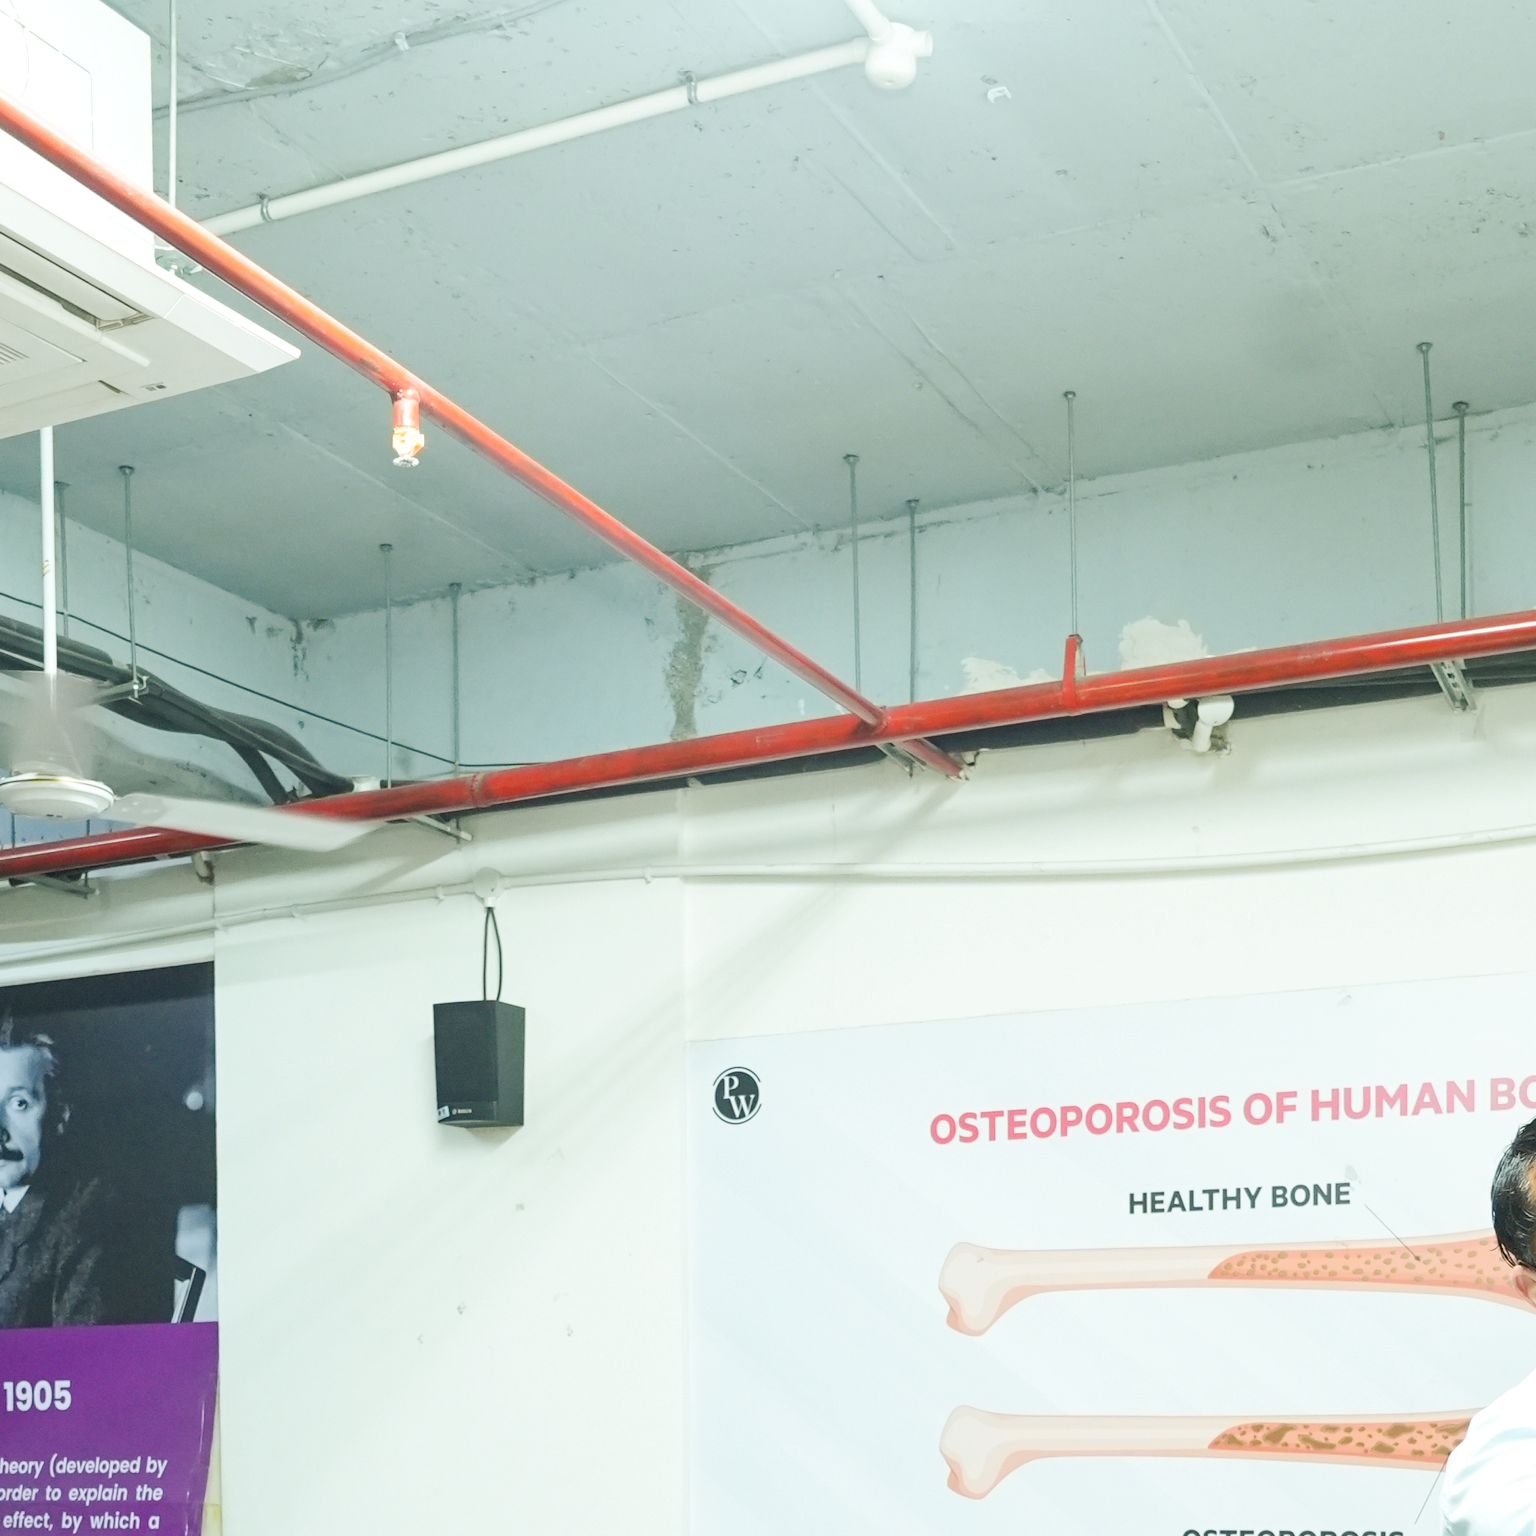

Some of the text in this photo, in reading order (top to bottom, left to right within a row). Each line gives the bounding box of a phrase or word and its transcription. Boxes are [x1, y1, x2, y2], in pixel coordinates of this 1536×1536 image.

[929, 1094, 1232, 1145] OSTEOPOROSIS
[1242, 1090, 1299, 1126] OF
[1310, 1078, 1476, 1122] HUMAN
[1128, 1182, 1352, 1215] HEALTHY BONE
[3, 1379, 71, 1412] 1905
[49, 1453, 141, 1479] (developed
[145, 1456, 168, 1479] by
[45, 1485, 62, 1501] to
[68, 1484, 128, 1506] explain
[135, 1484, 164, 1501] the
[2, 1511, 55, 1531] effect,
[61, 1512, 83, 1534] by
[90, 1512, 140, 1529] which
[148, 1515, 160, 1529] a
